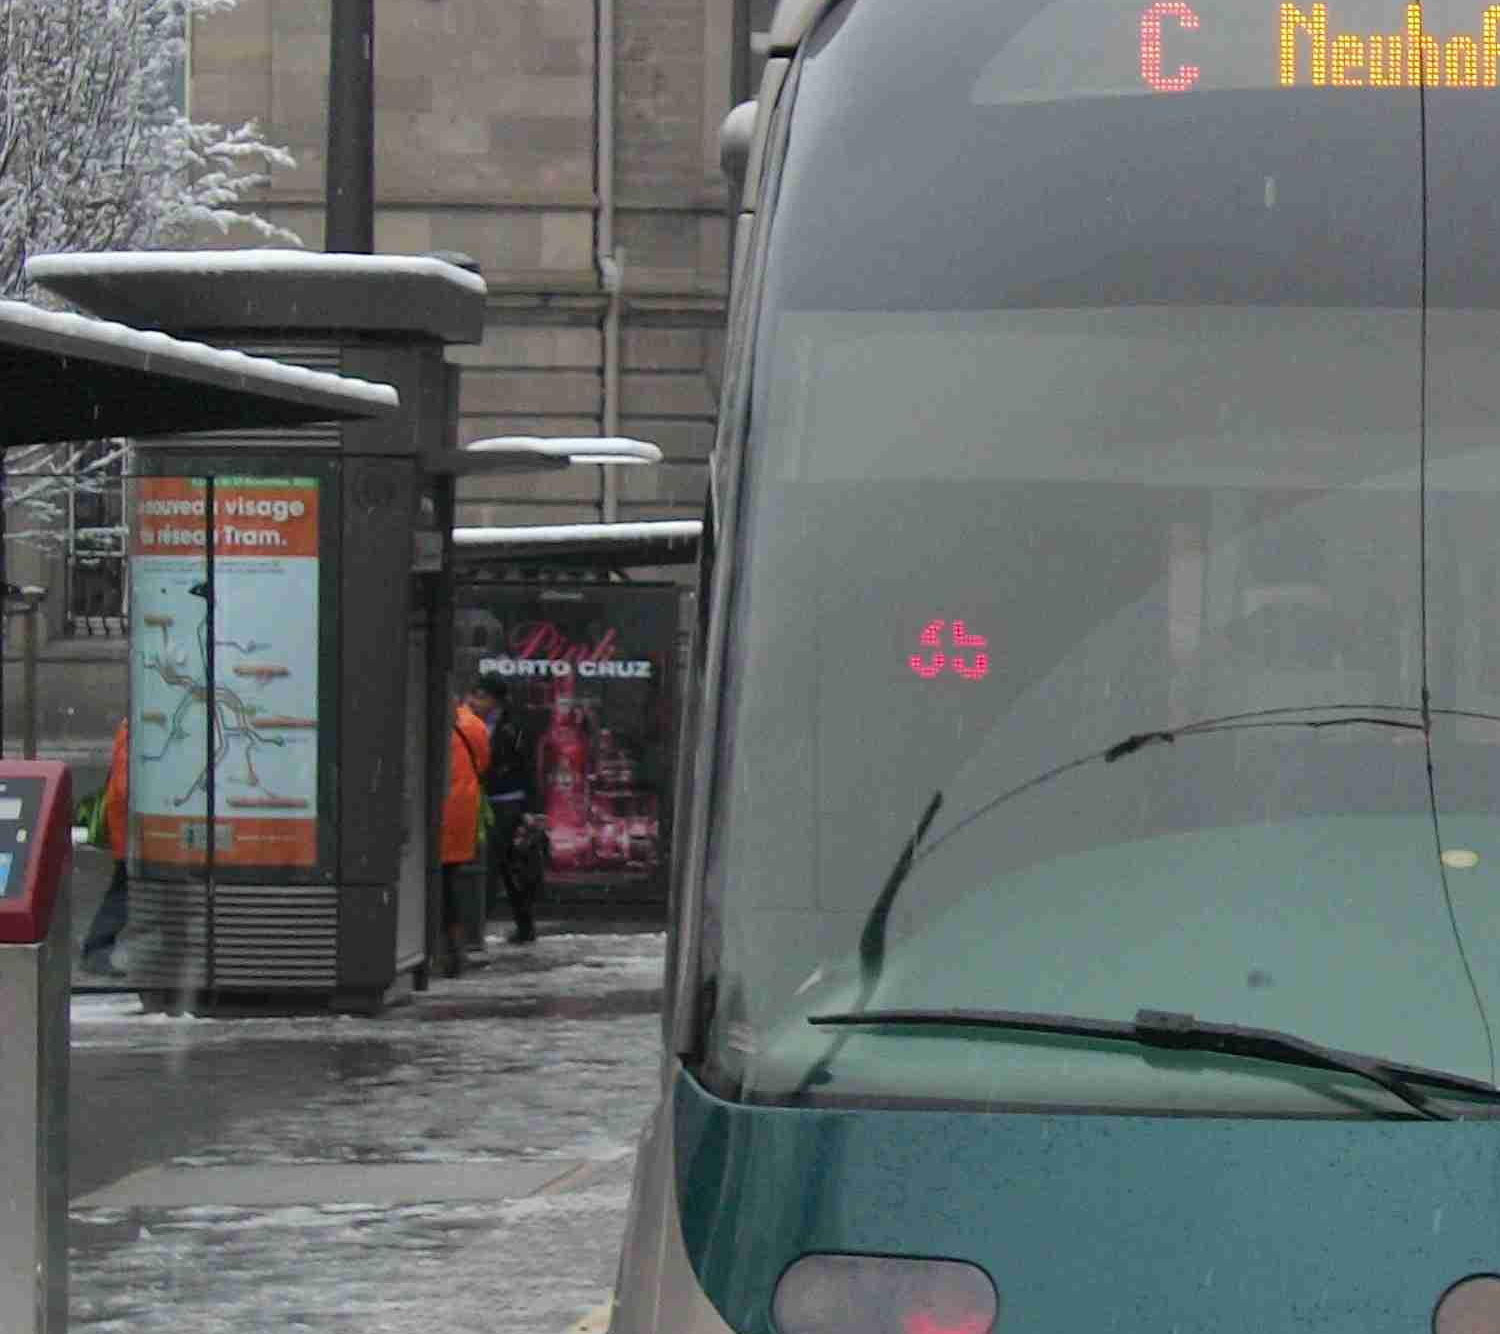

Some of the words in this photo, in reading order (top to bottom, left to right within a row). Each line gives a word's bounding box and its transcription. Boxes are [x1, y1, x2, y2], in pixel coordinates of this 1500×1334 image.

[1139, 1, 1200, 92] C
[224, 496, 305, 523] visage
[478, 658, 572, 677] PORTO
[577, 659, 653, 678] CRUZ
